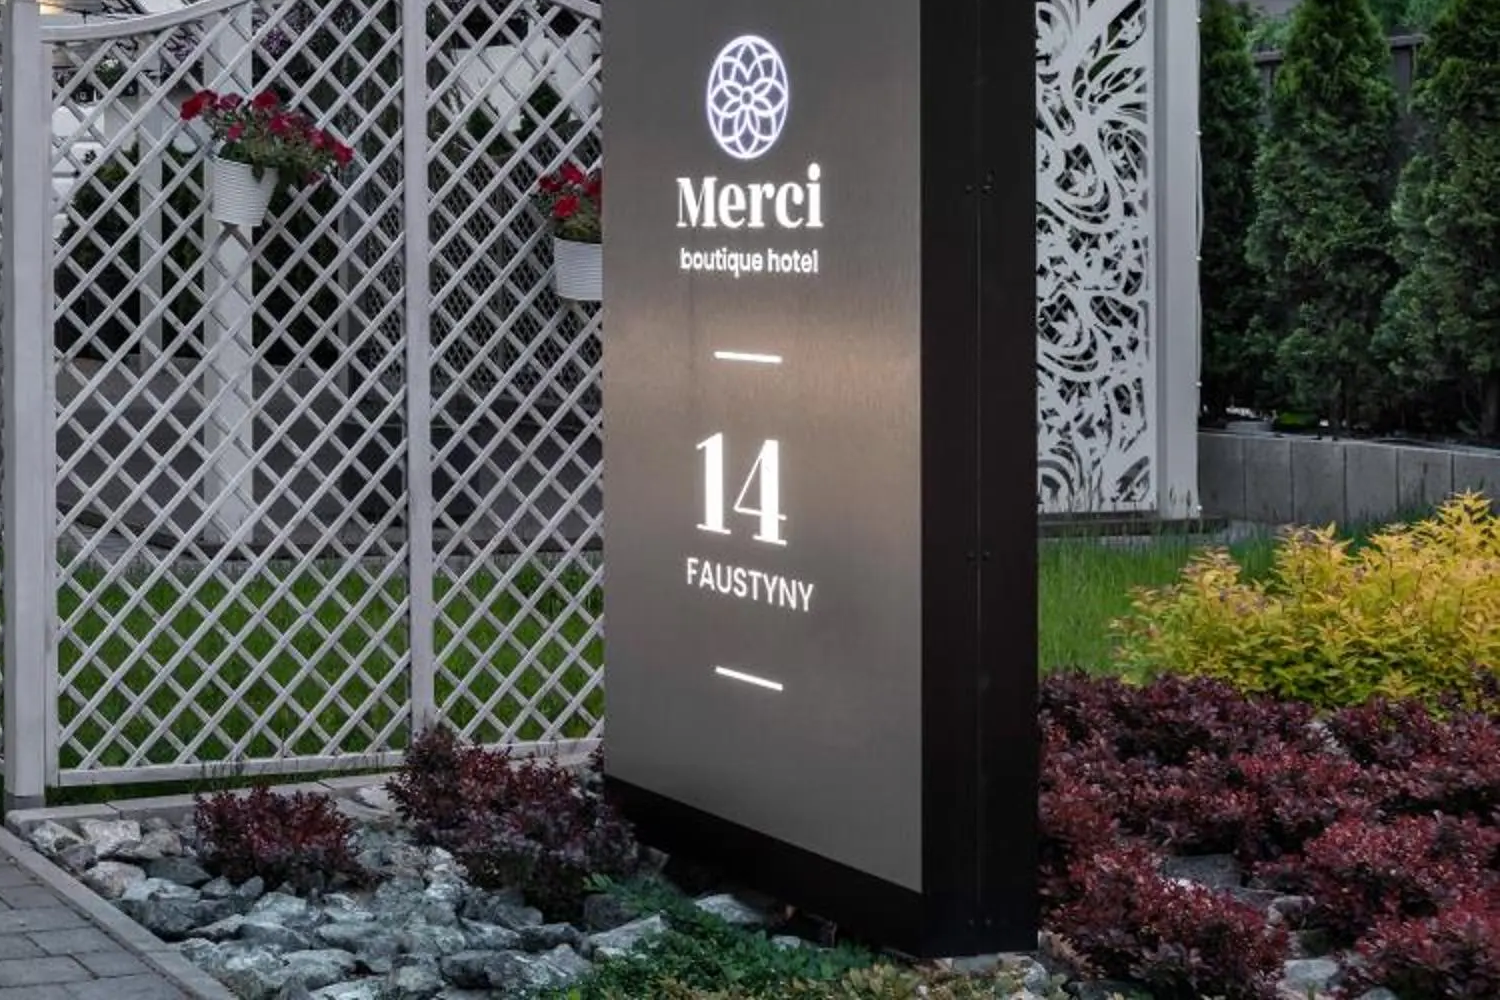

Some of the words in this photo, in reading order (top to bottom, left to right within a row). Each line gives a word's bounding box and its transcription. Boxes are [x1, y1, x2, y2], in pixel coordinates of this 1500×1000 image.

[676, 163, 823, 229] Merci
[680, 247, 763, 278] boutique
[767, 248, 819, 272] hotel
[696, 432, 788, 545] 14
[686, 557, 814, 611] FAUSTYNY
